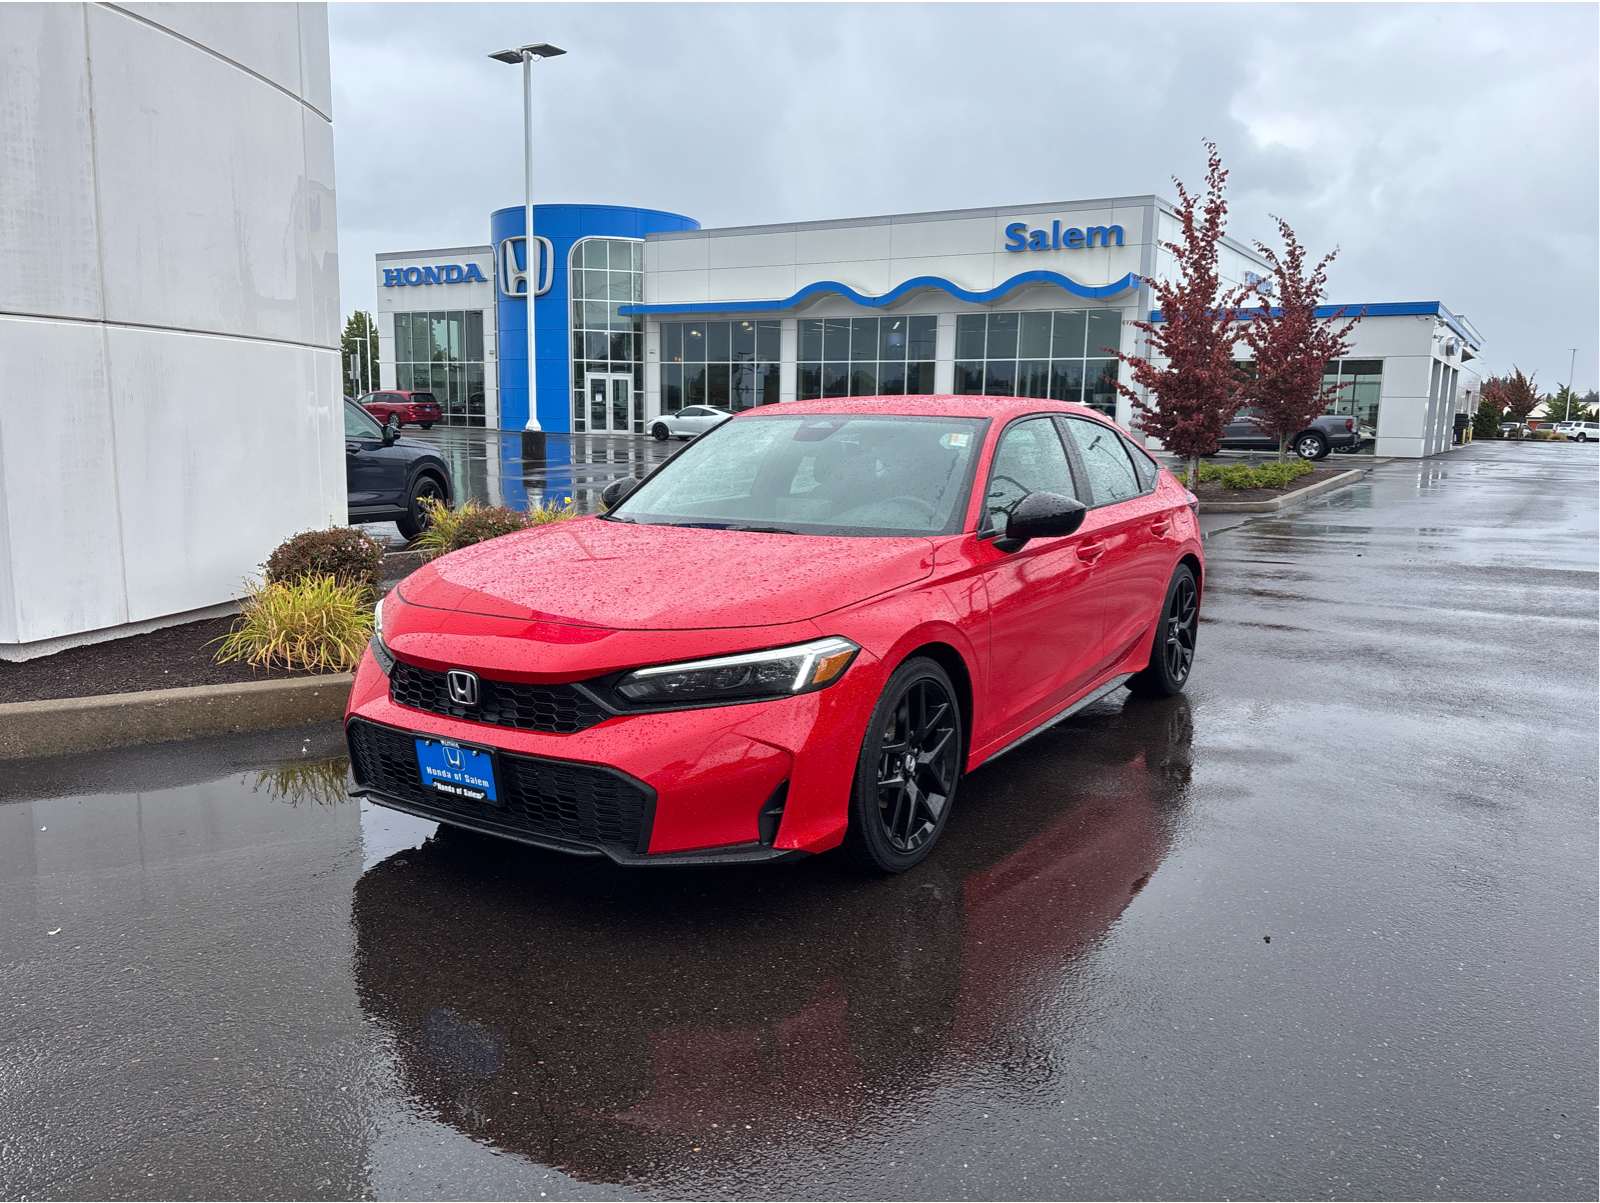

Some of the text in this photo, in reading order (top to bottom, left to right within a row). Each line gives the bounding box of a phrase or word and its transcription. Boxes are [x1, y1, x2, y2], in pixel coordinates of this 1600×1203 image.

[1004, 219, 1126, 252] Salem
[382, 263, 488, 288] HONDA
[426, 766, 489, 787] Honda of Salem
